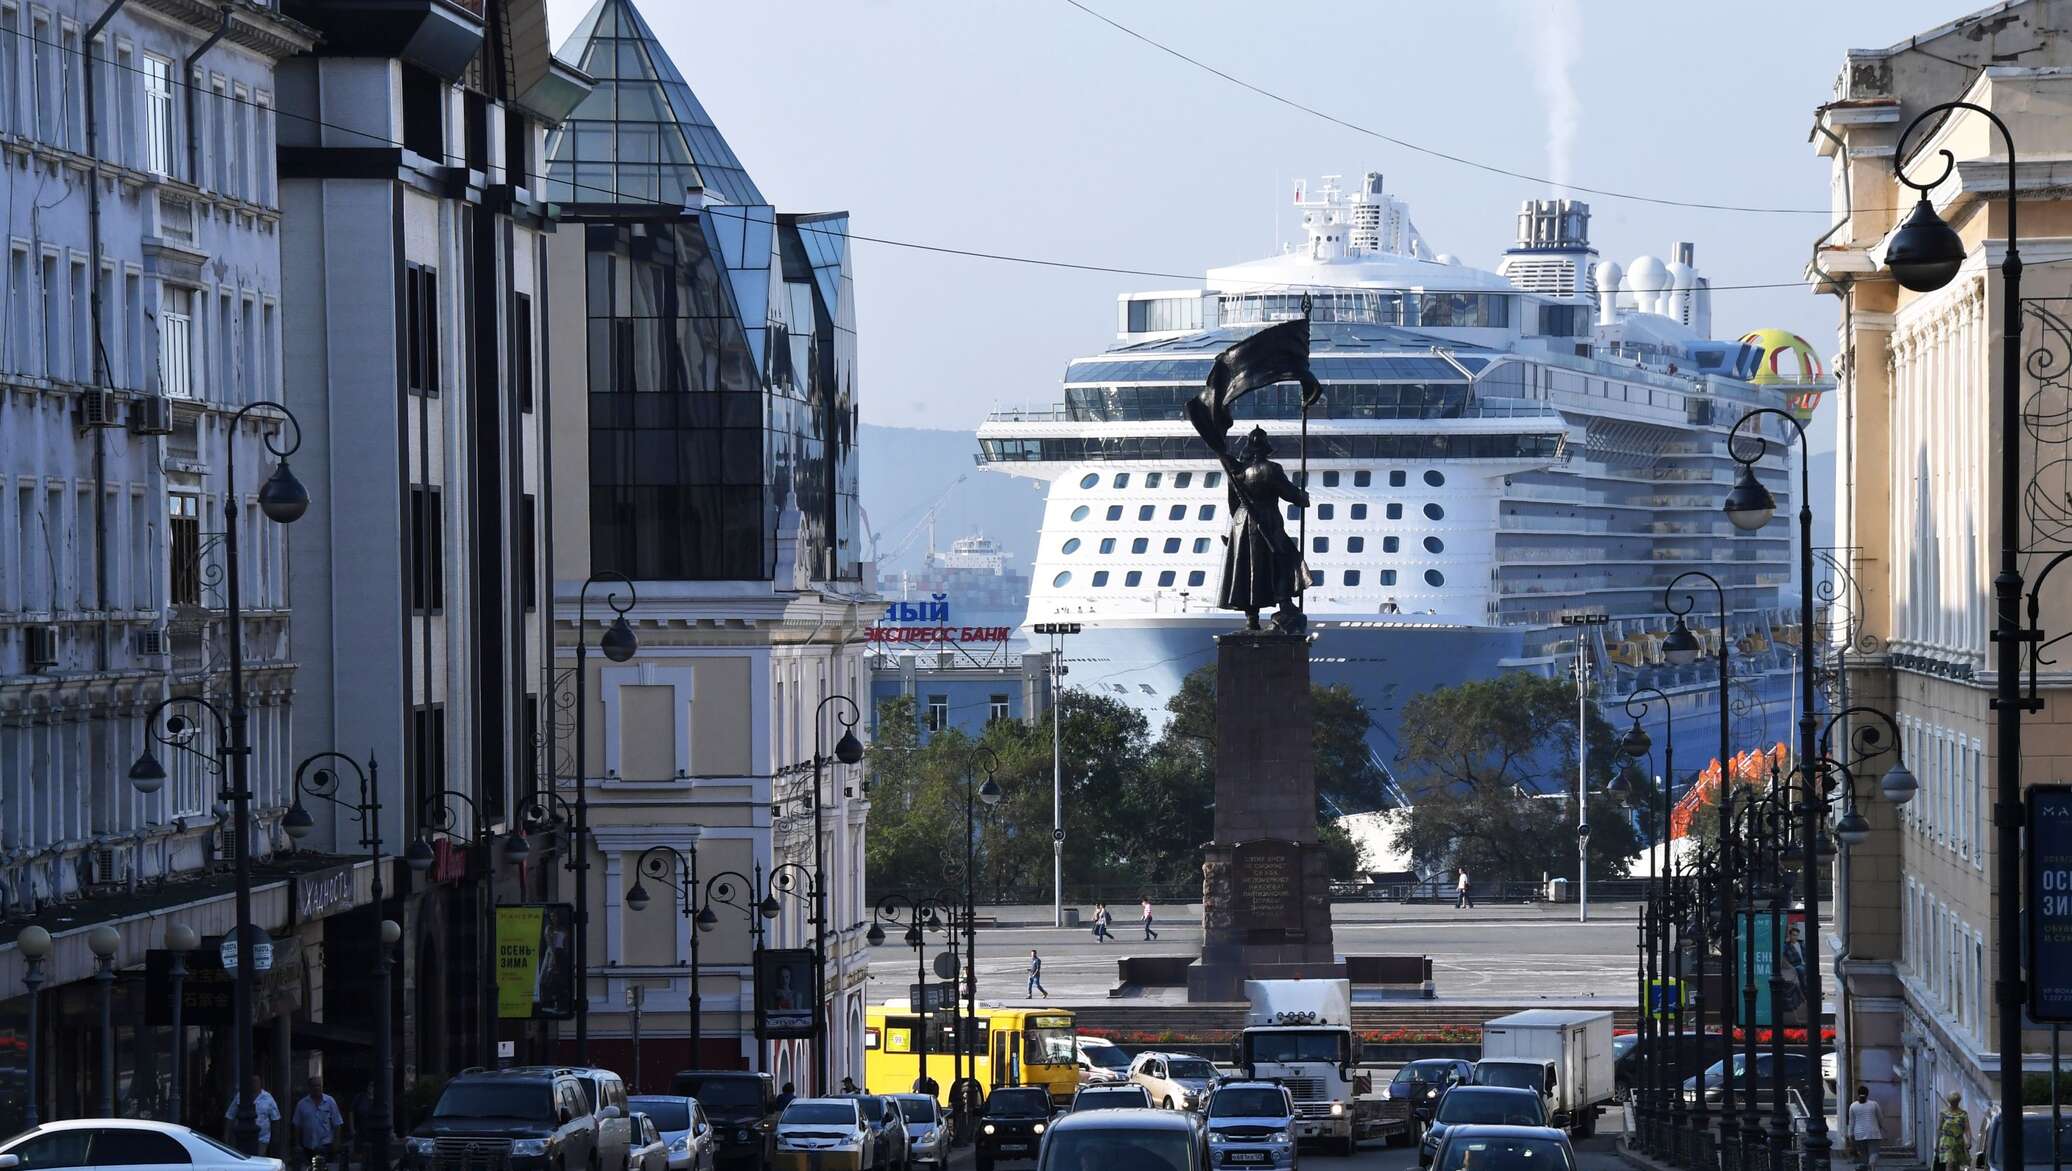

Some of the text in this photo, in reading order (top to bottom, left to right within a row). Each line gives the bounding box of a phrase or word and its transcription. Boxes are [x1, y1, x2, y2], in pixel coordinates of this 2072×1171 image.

[864, 627, 1011, 643] ЭКСПРЕСС БАНК
[2043, 895, 2072, 916] ЗИ
[500, 958, 528, 969] ЗИМА
